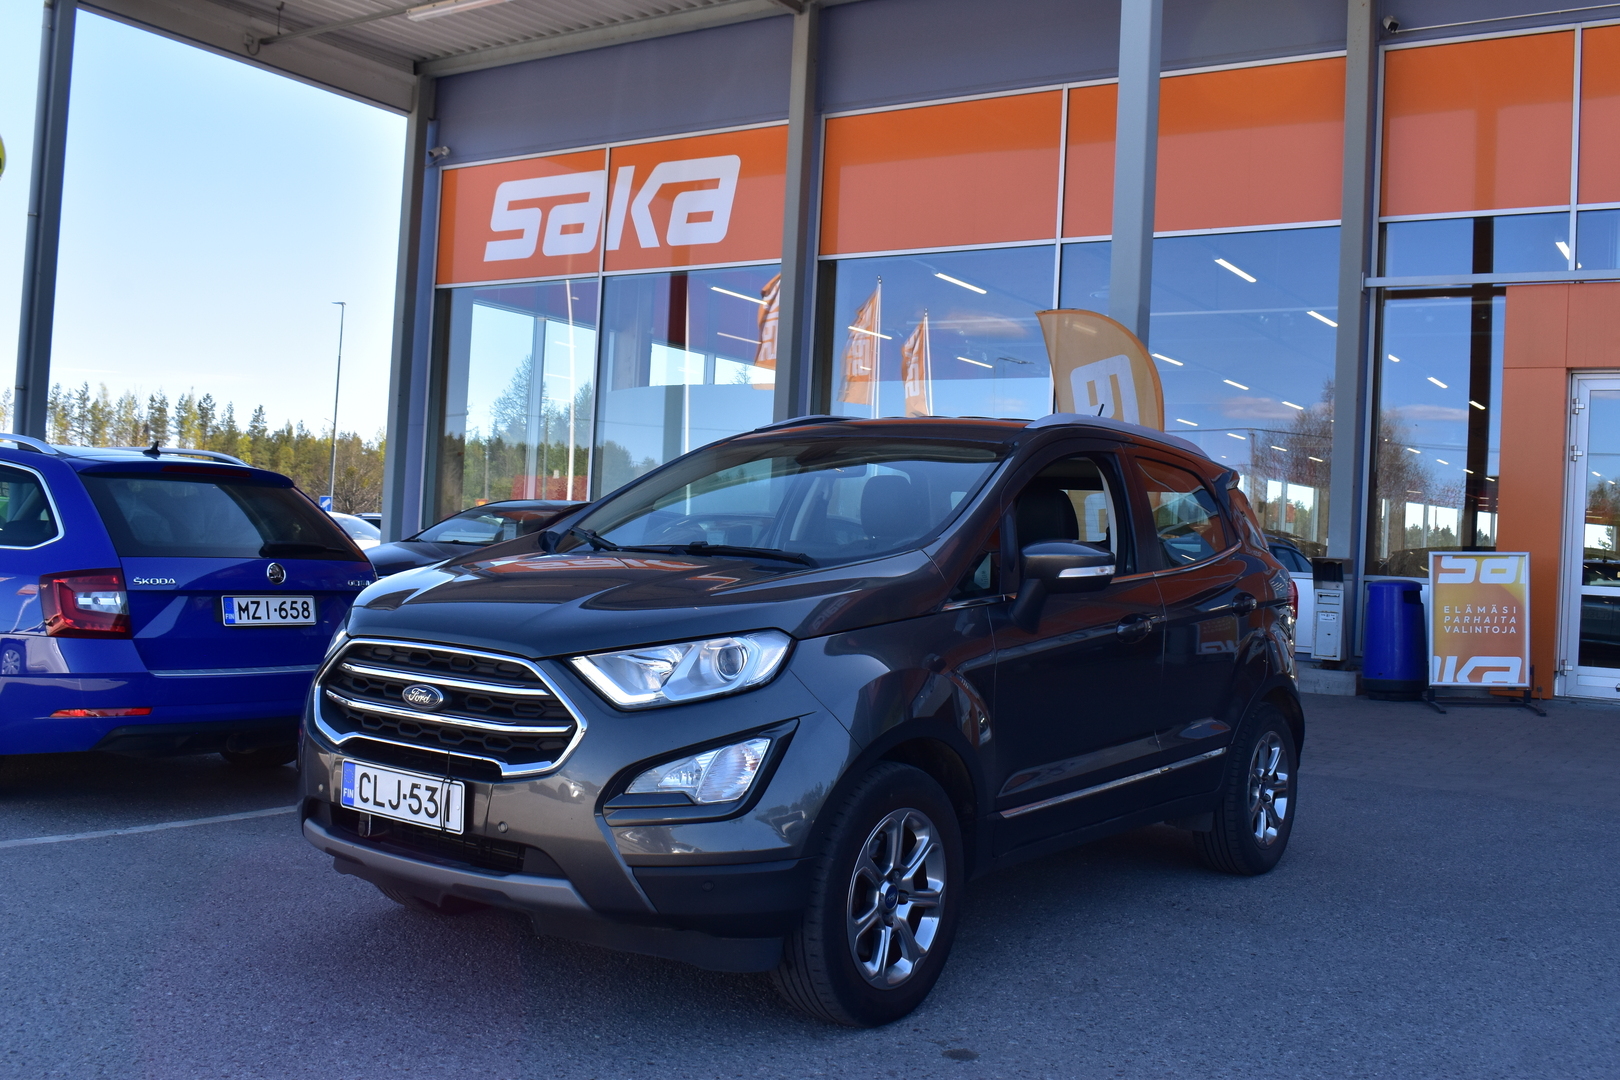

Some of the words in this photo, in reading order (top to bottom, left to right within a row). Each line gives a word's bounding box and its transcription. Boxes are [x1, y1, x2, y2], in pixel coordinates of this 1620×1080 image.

[236, 600, 311, 621] MZI-658
[1443, 604, 1517, 614] ELÄMÄSI
[1443, 615, 1517, 624] PARHAITA
[1443, 625, 1517, 634] VALINTOJA
[408, 687, 432, 704] Ford
[343, 787, 355, 799] FIN
[358, 771, 451, 823] CLJ-531
